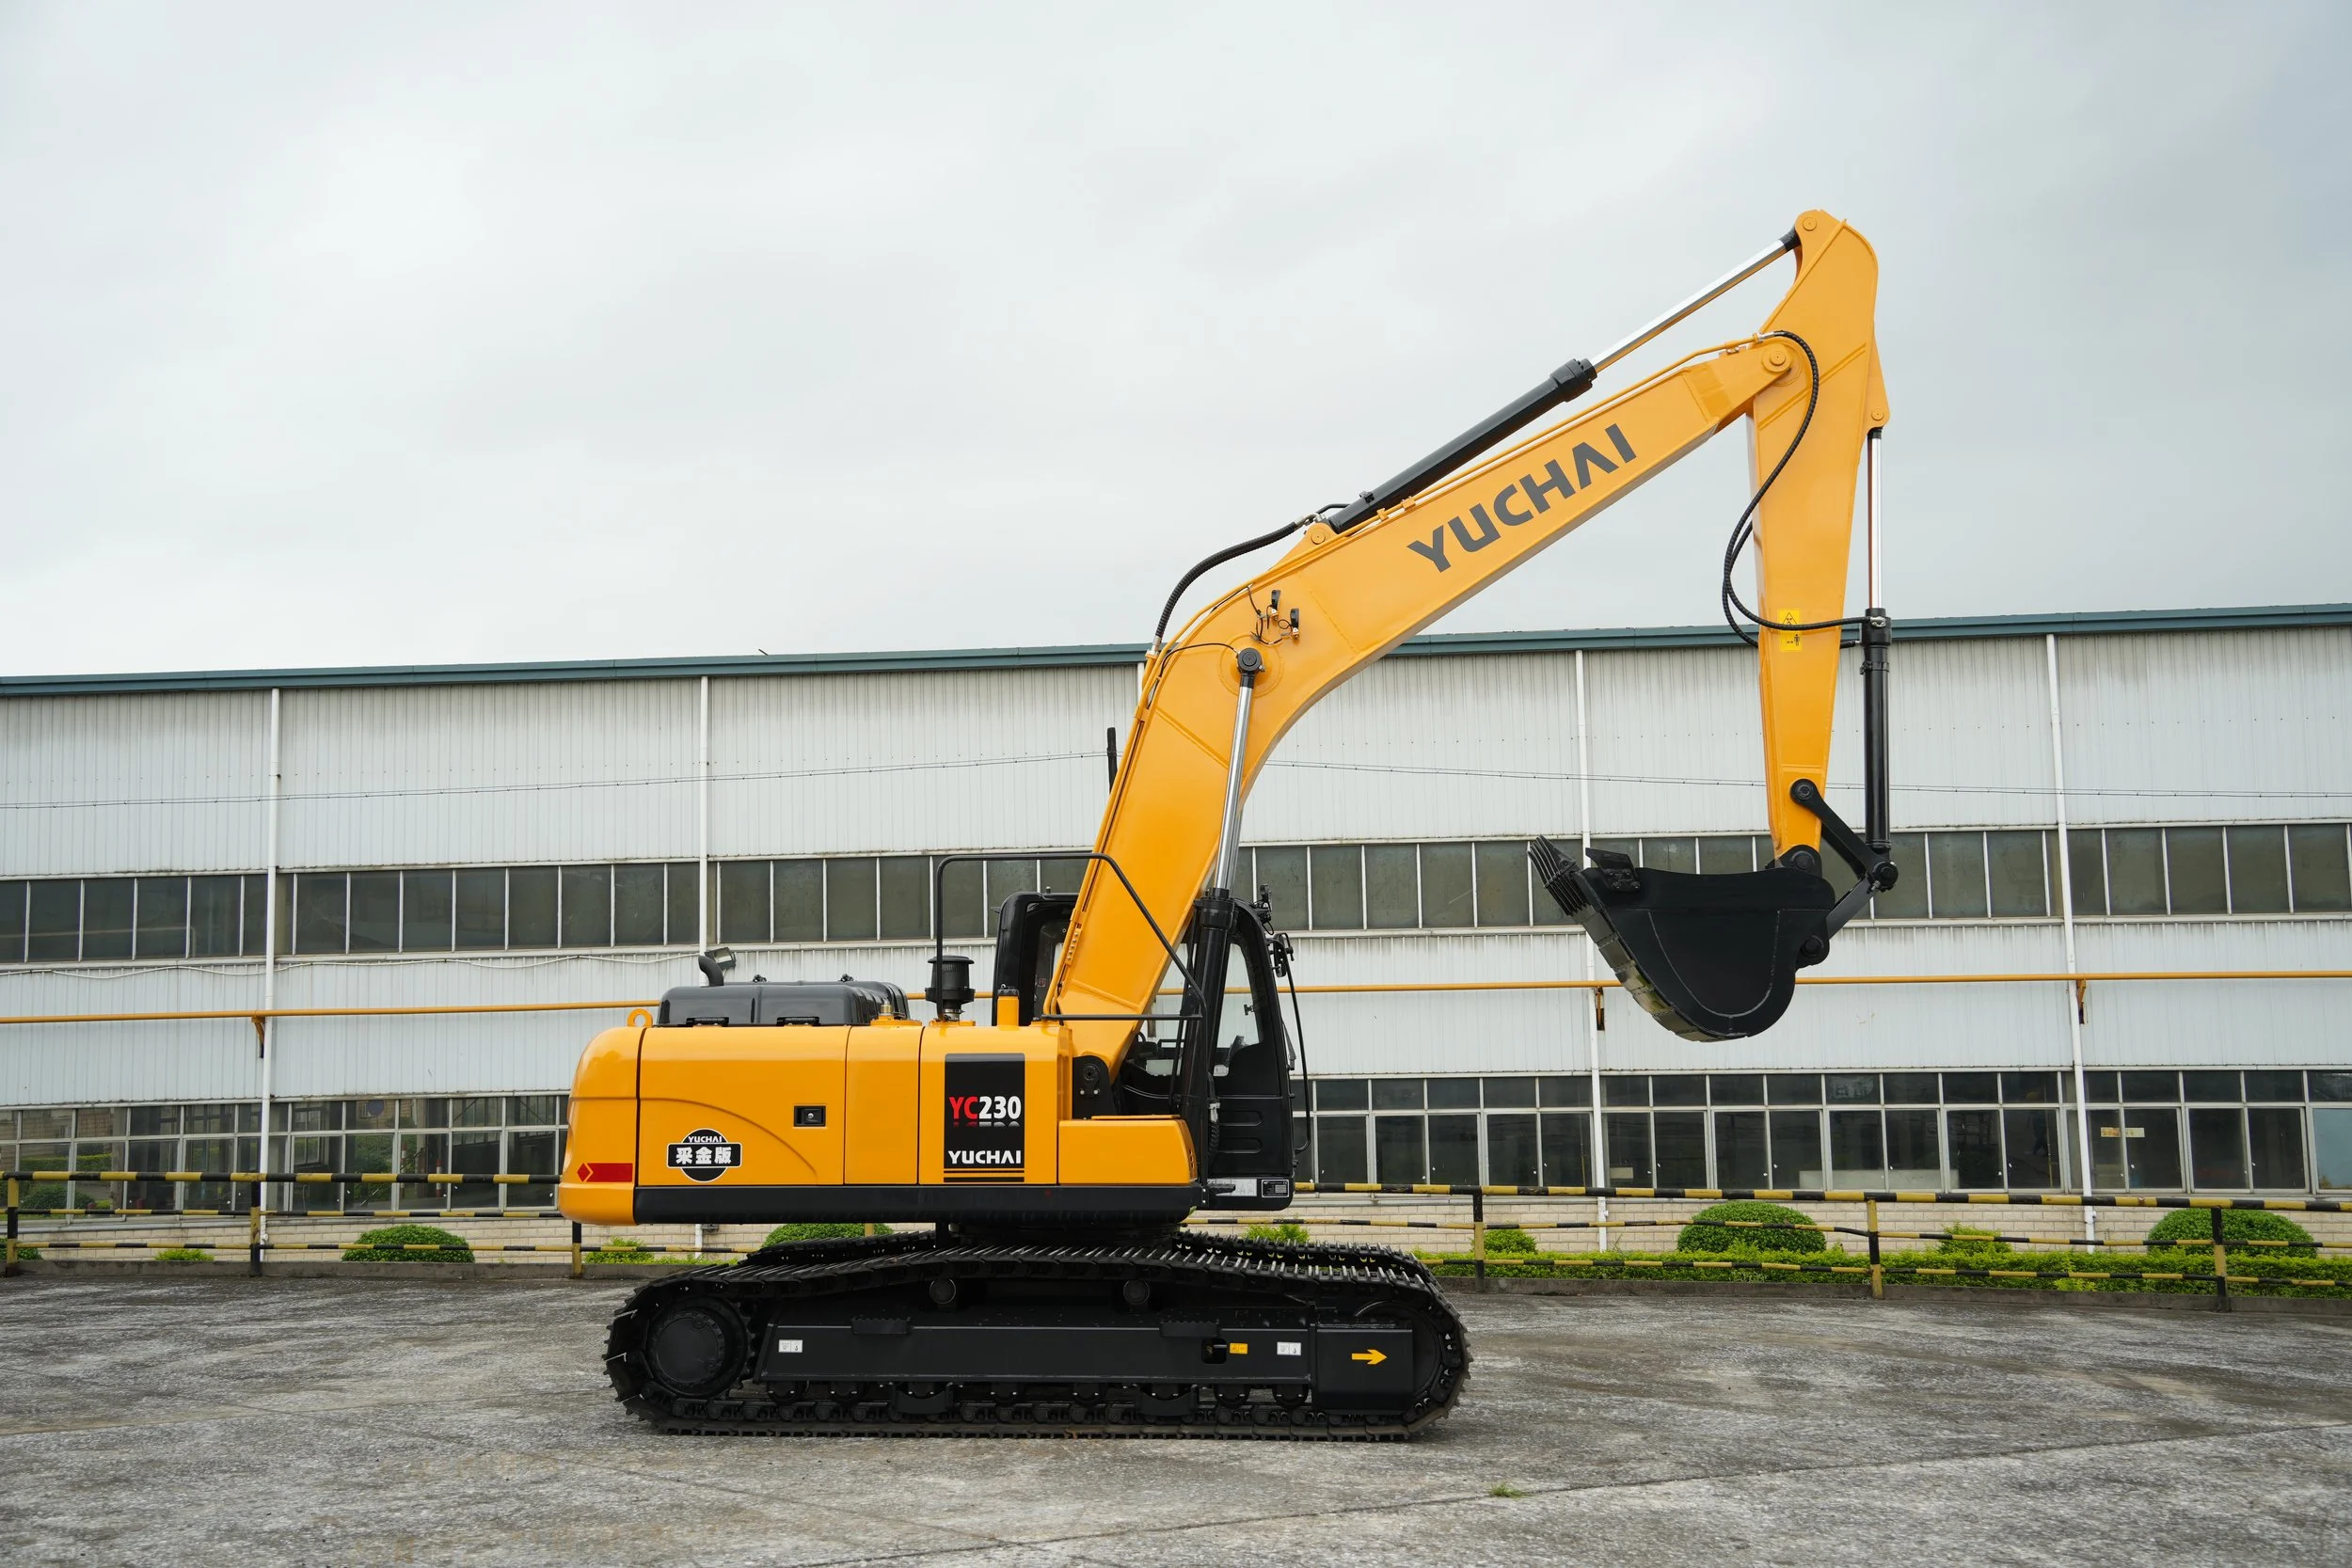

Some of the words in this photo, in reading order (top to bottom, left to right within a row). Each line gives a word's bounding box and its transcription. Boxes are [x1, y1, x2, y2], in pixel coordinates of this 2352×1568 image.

[1406, 422, 1637, 573] YUCHAI
[948, 1096, 1022, 1119] YC230
[675, 1146, 732, 1165] 采金版
[947, 1149, 1022, 1164] YUCHAI
